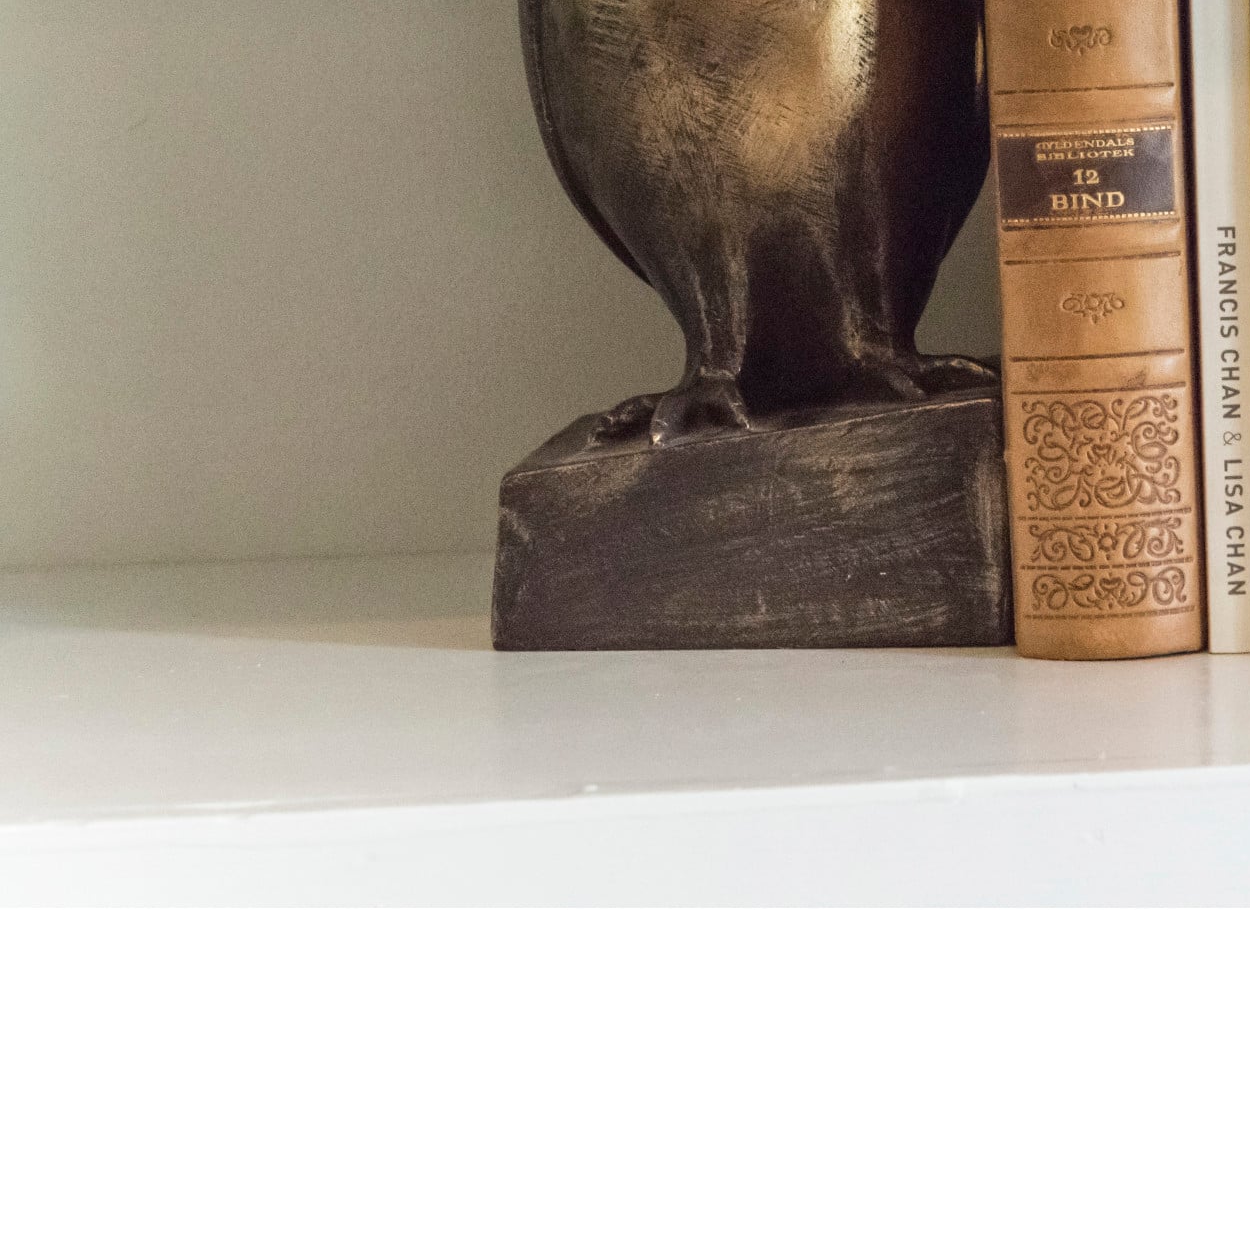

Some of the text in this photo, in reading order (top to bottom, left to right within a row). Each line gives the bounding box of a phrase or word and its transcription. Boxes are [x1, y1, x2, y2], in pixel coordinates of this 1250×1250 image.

[1034, 137, 1135, 150] GYLDENDALS
[1036, 148, 1136, 162] BIBLIOTEK
[1072, 168, 1100, 185] 12
[1051, 191, 1126, 210] BIND
[1217, 225, 1247, 596] FRANCIS CHAN & LISA CHAN
